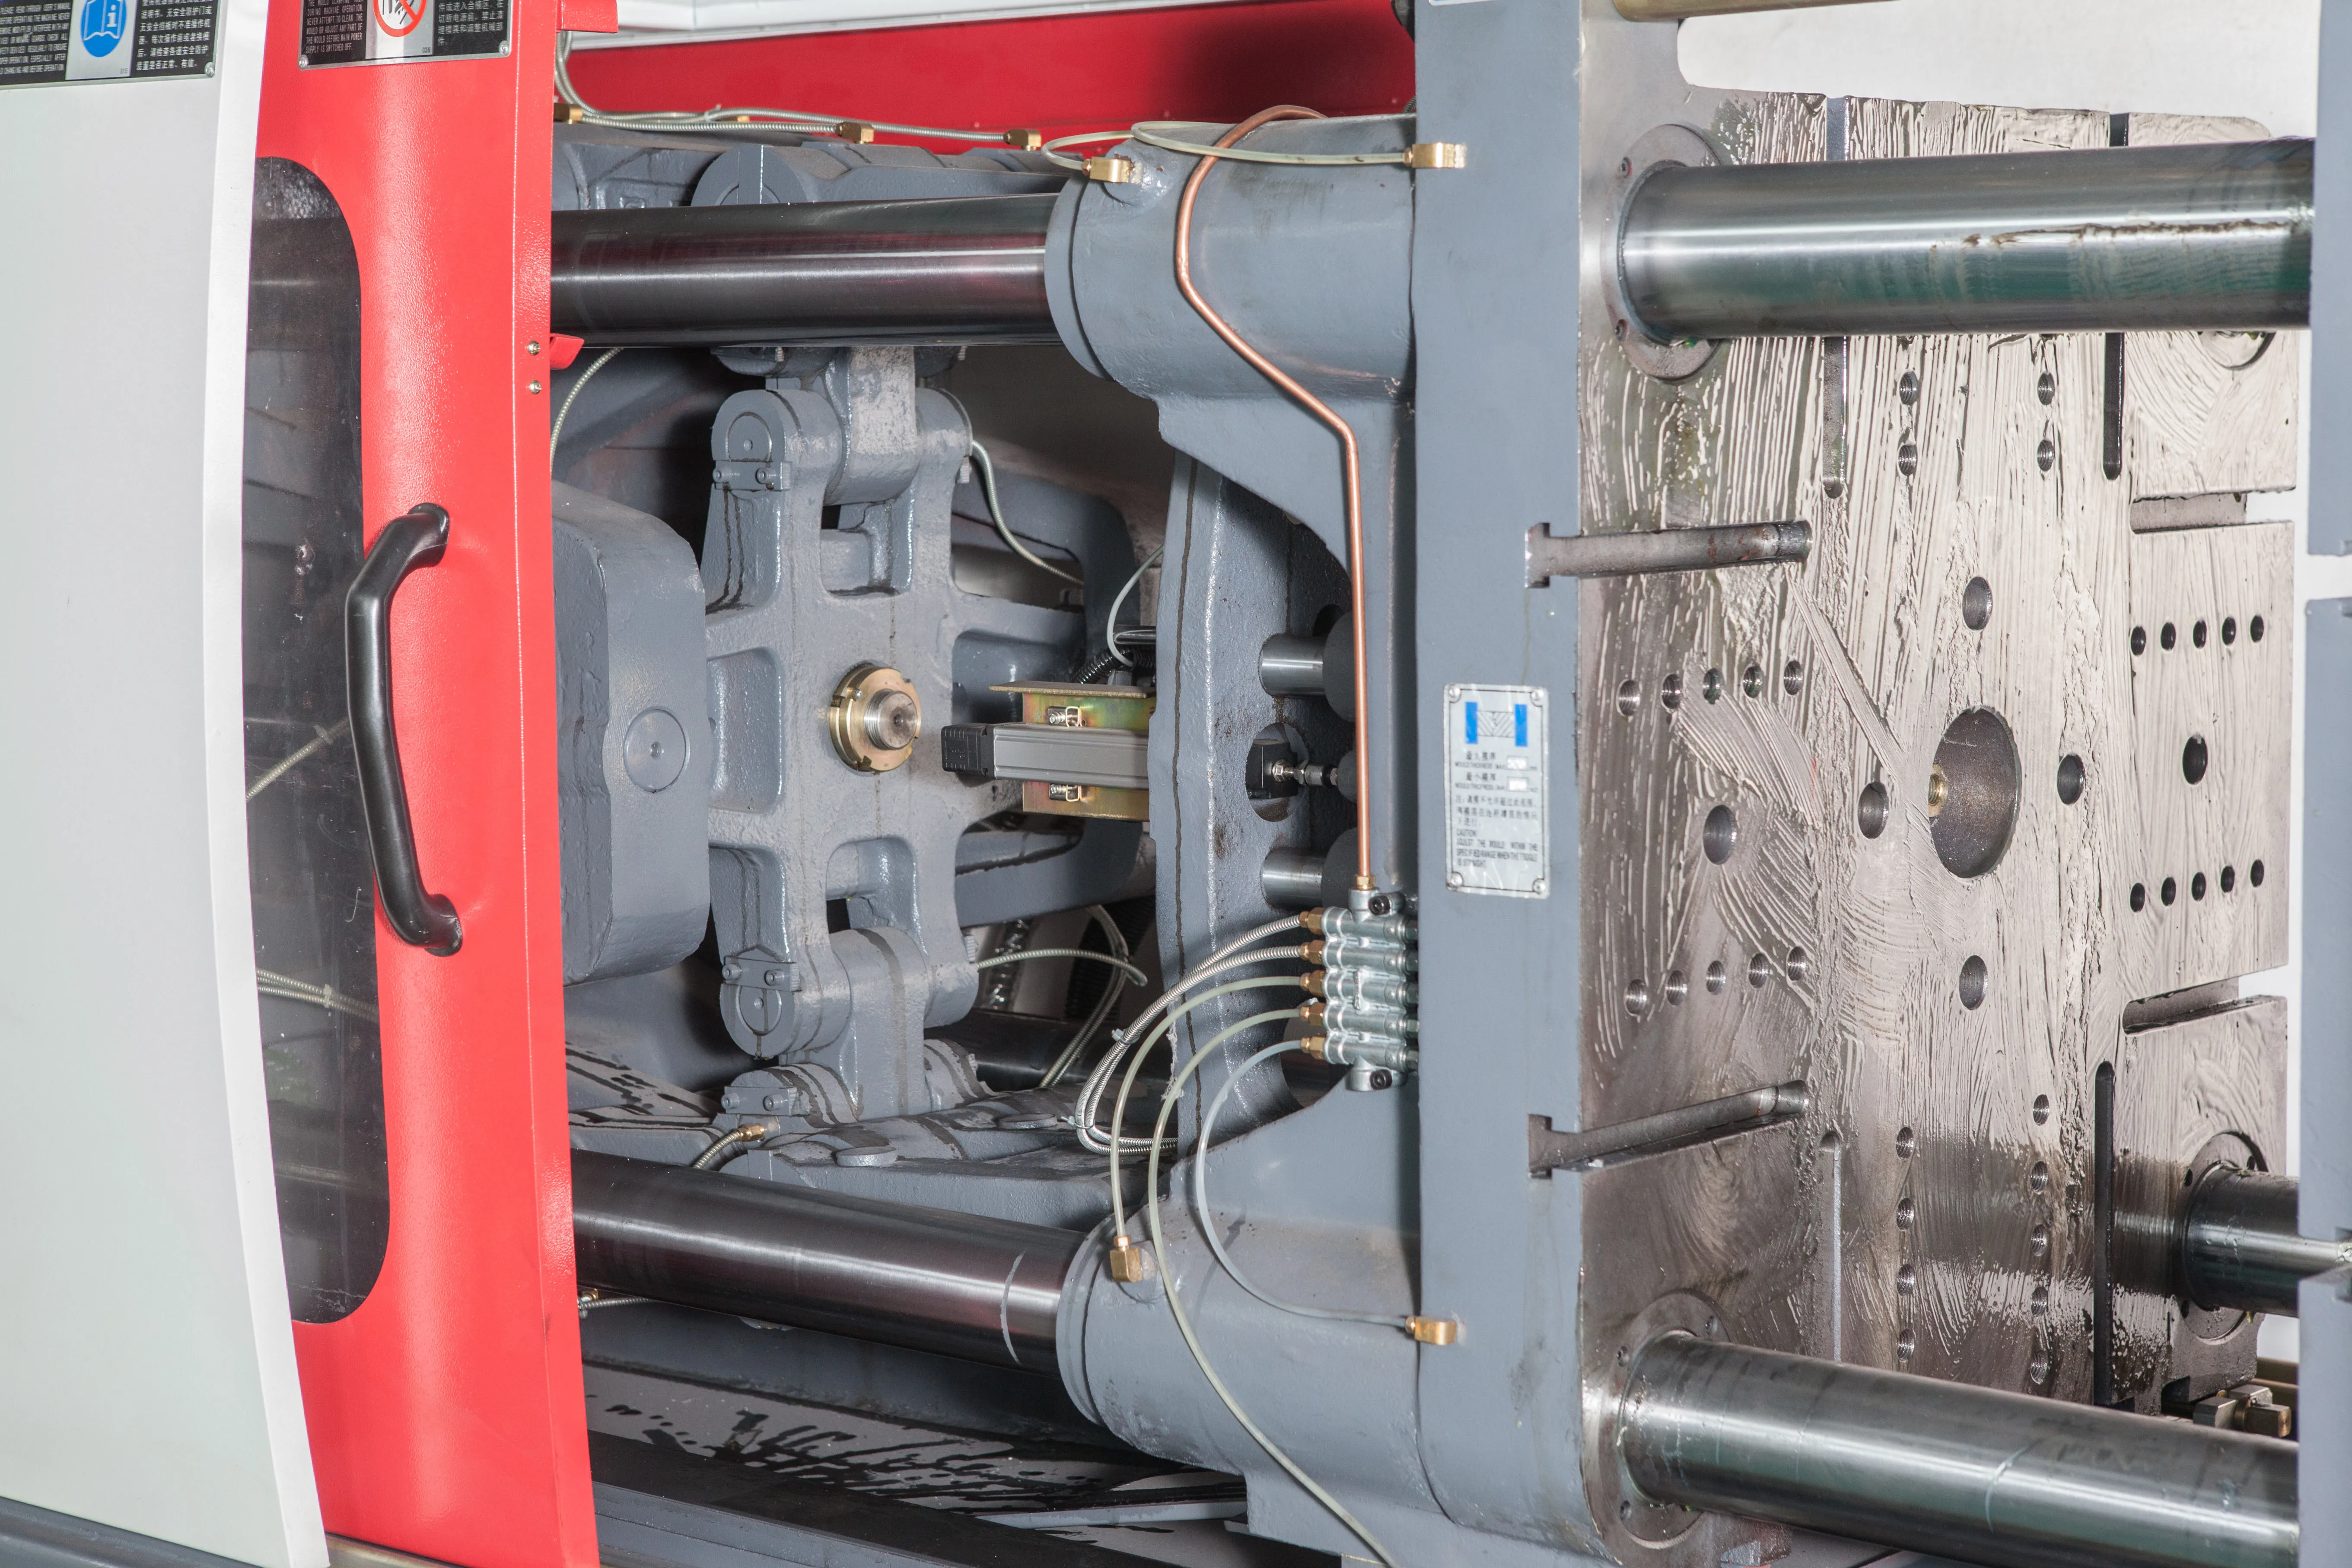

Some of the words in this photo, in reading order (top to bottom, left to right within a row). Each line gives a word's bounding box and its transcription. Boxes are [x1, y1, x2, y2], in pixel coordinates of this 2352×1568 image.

[307, 8, 321, 16] DURING
[324, 6, 339, 14] MACHINE
[319, 16, 335, 24] ATTEMPT
[306, 27, 318, 35] MOULD
[325, 25, 338, 33] ADJUST
[314, 35, 325, 44] MOULD
[326, 34, 340, 42] BEFORE
[351, 32, 362, 41] POWER
[306, 45, 319, 54] SUPPLY
[326, 44, 343, 52] SWITCHED
